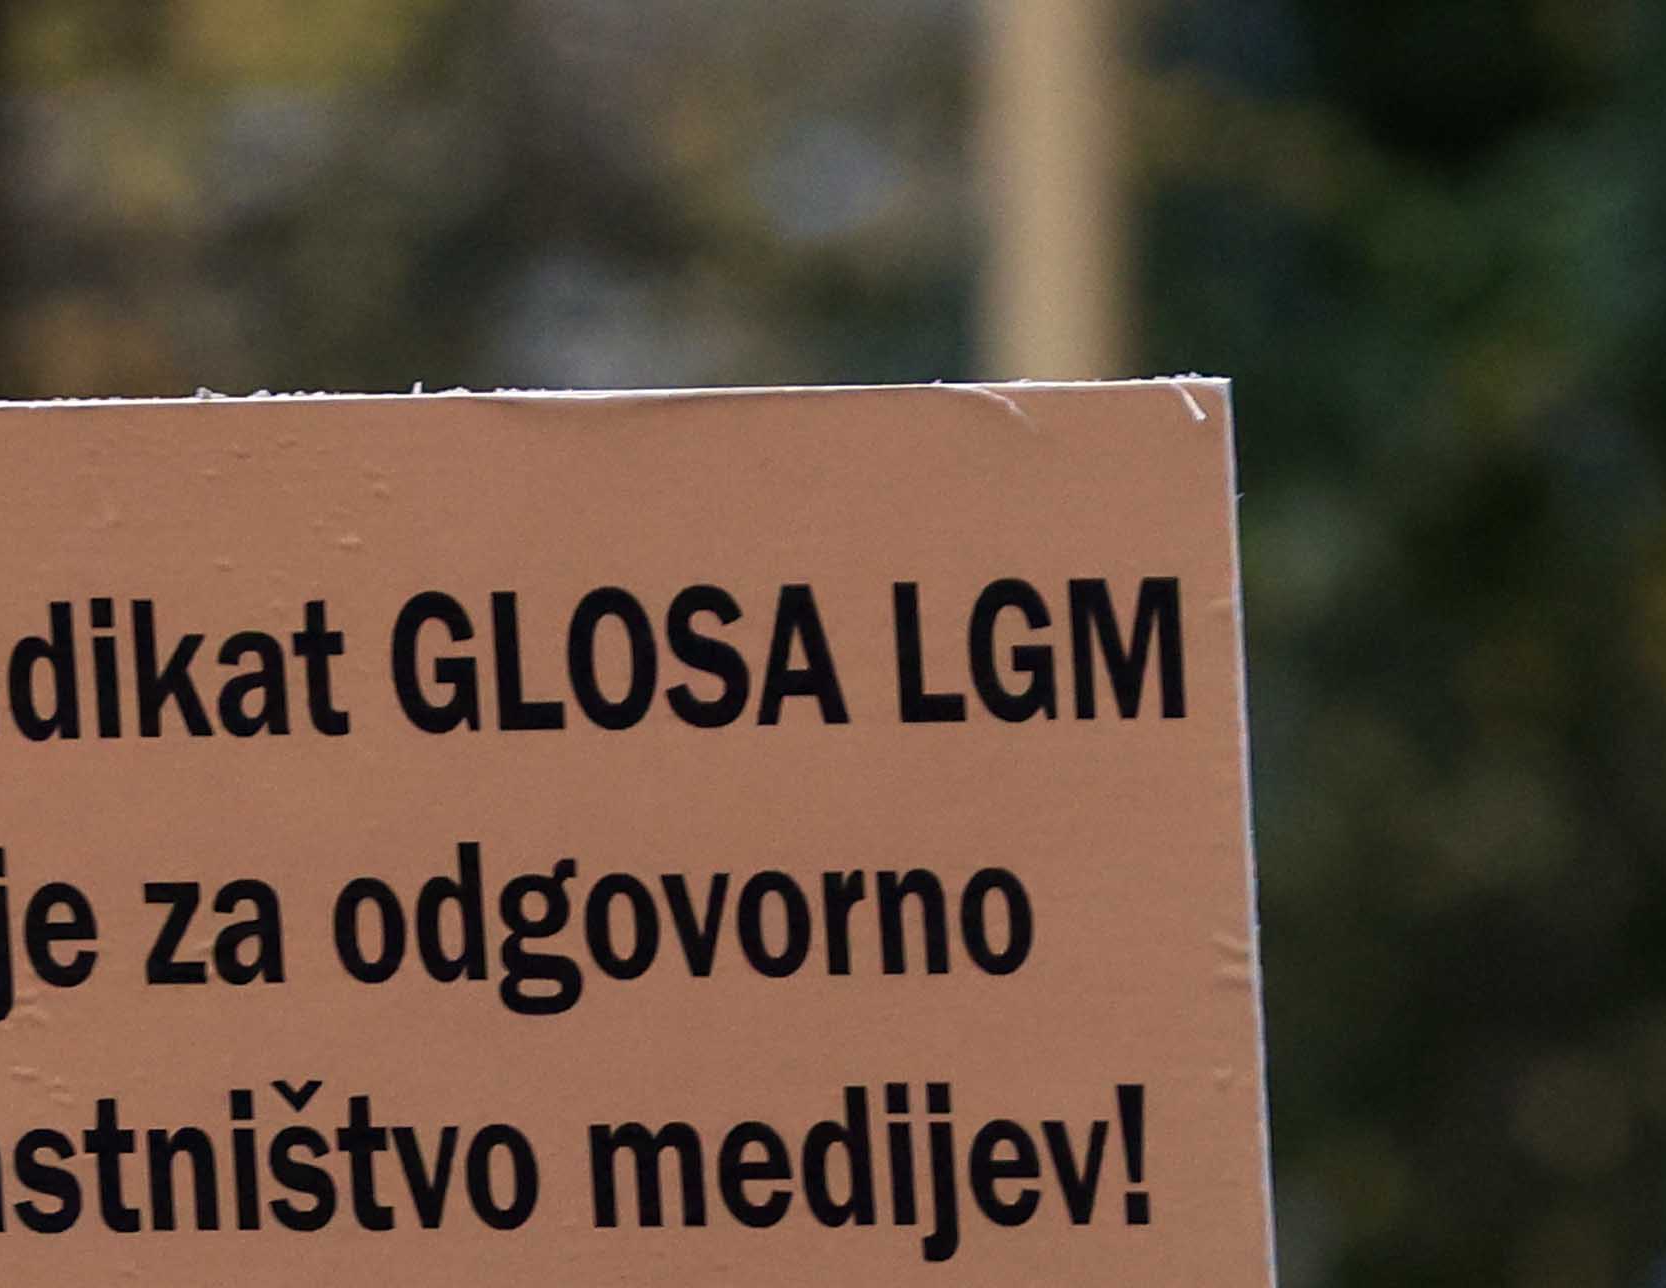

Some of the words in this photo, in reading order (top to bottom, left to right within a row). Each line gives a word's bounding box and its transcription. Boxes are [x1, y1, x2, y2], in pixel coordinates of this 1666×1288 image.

[390, 583, 852, 735] GLOSA
[892, 576, 1187, 724] LGM
[143, 880, 286, 988] za
[333, 841, 1034, 1016] odgovorno
[588, 1081, 1151, 1263] medijev!
